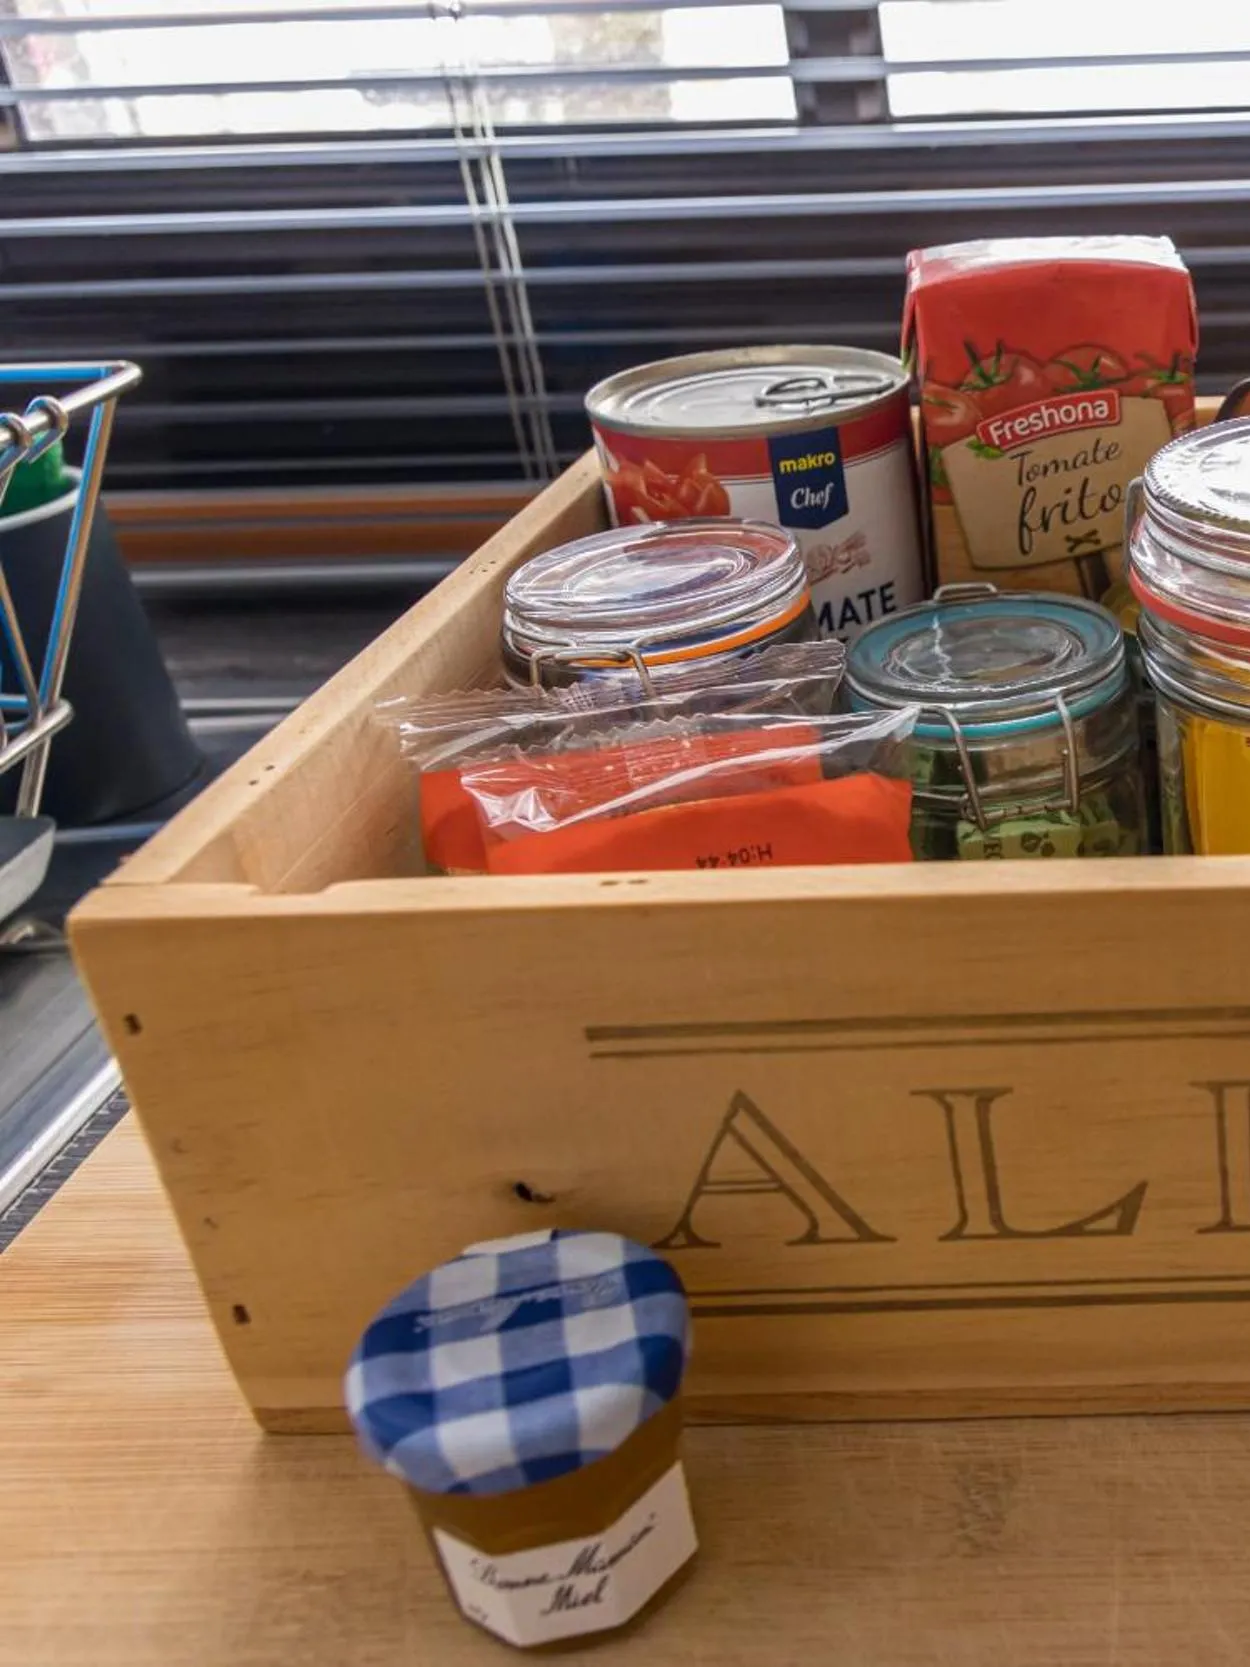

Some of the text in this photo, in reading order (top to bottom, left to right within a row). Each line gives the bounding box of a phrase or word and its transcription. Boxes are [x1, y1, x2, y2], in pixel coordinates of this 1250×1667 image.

[989, 400, 1109, 446] Freshona
[779, 451, 836, 475] makro
[1009, 438, 1119, 487] Tomate
[790, 481, 835, 510] Chef
[1018, 476, 1123, 557] frito
[818, 580, 897, 632] MATE
